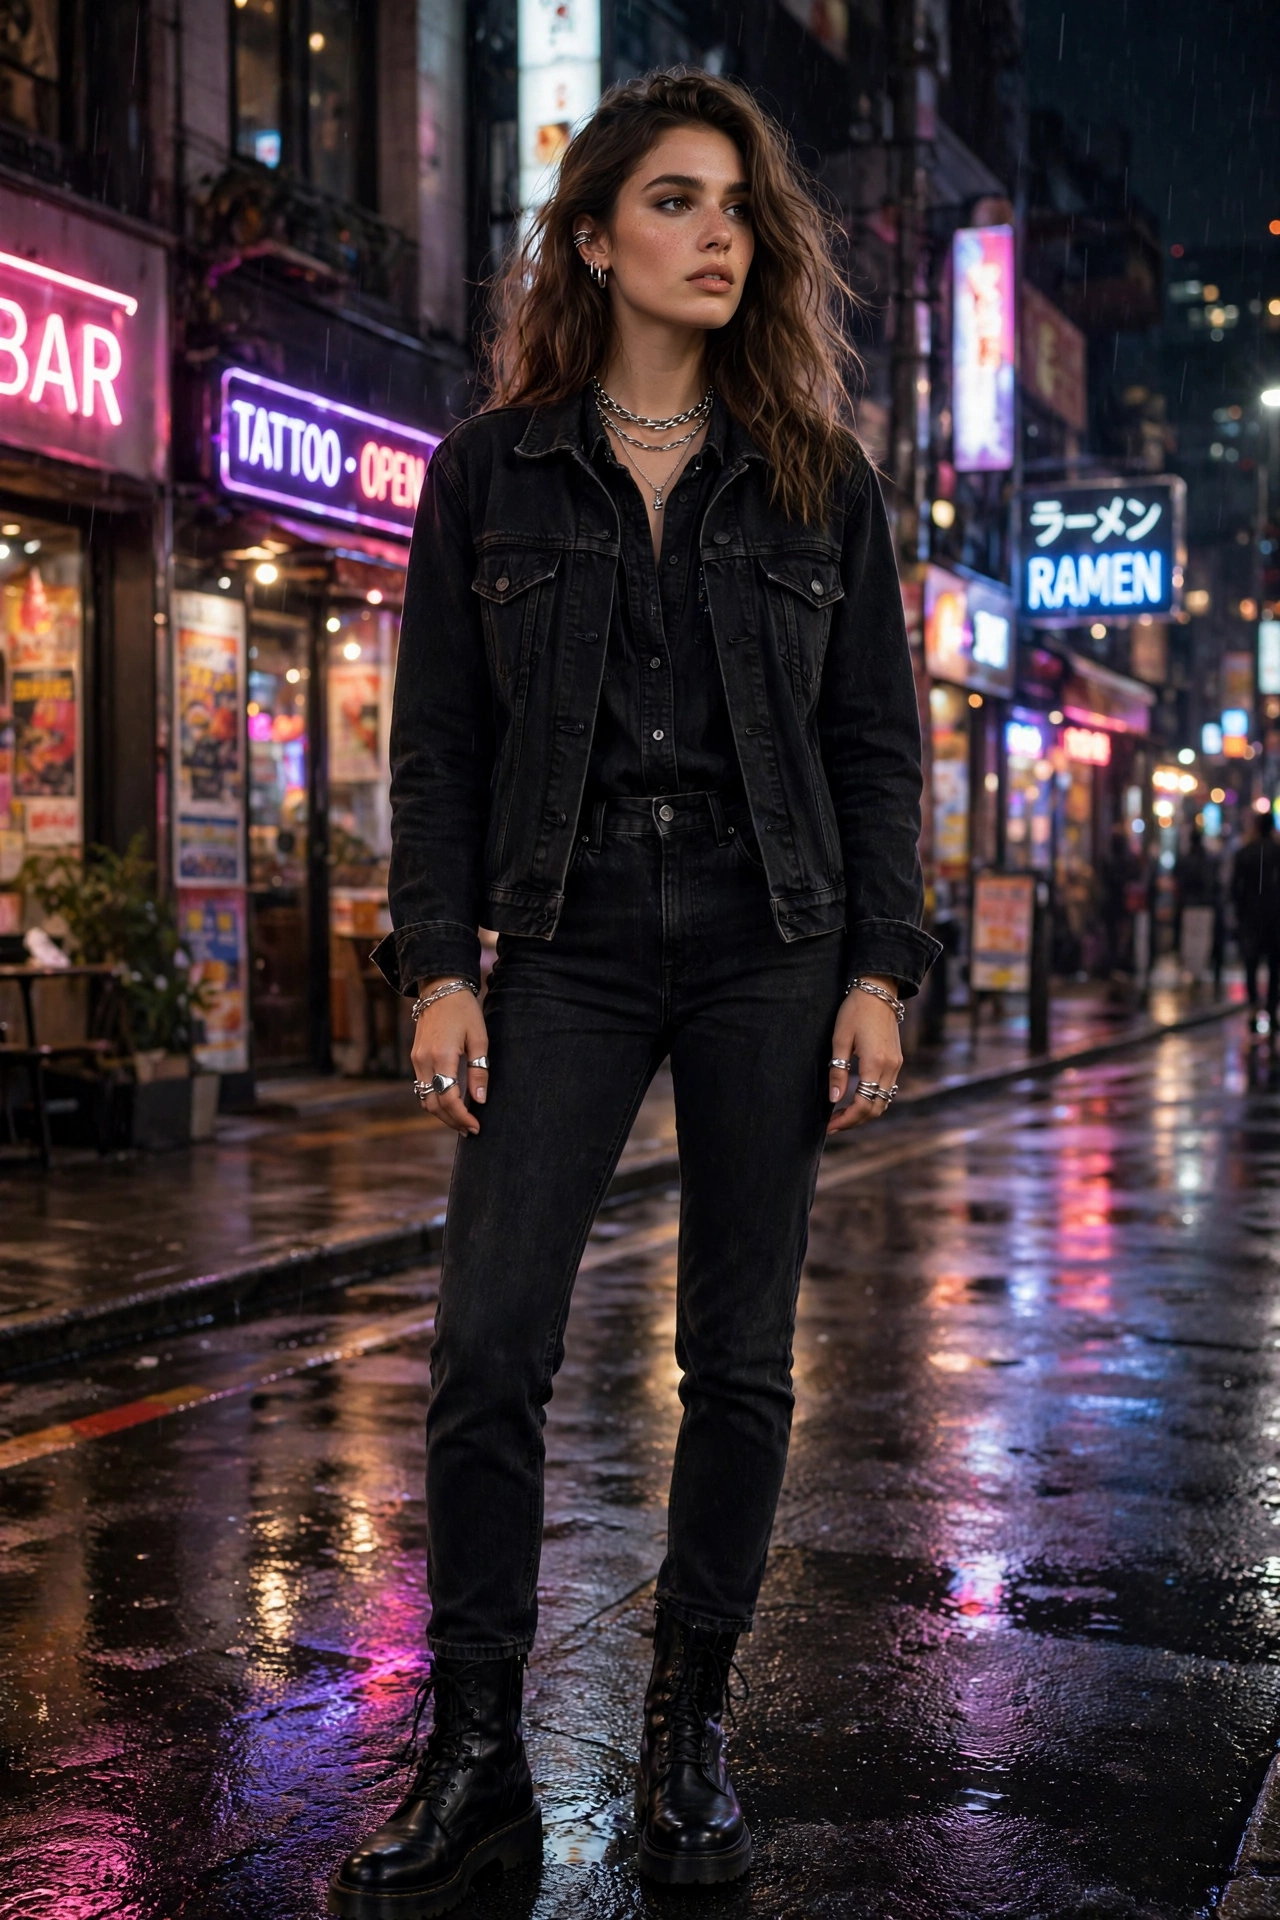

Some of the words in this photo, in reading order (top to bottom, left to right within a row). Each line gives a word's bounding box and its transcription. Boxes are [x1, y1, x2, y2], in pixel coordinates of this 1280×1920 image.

[0, 297, 123, 426] BAR
[231, 400, 341, 487] TATTOO
[360, 441, 425, 509] OPEN
[1030, 497, 1162, 547] ラーメン
[1028, 551, 1162, 609] RAMEN
